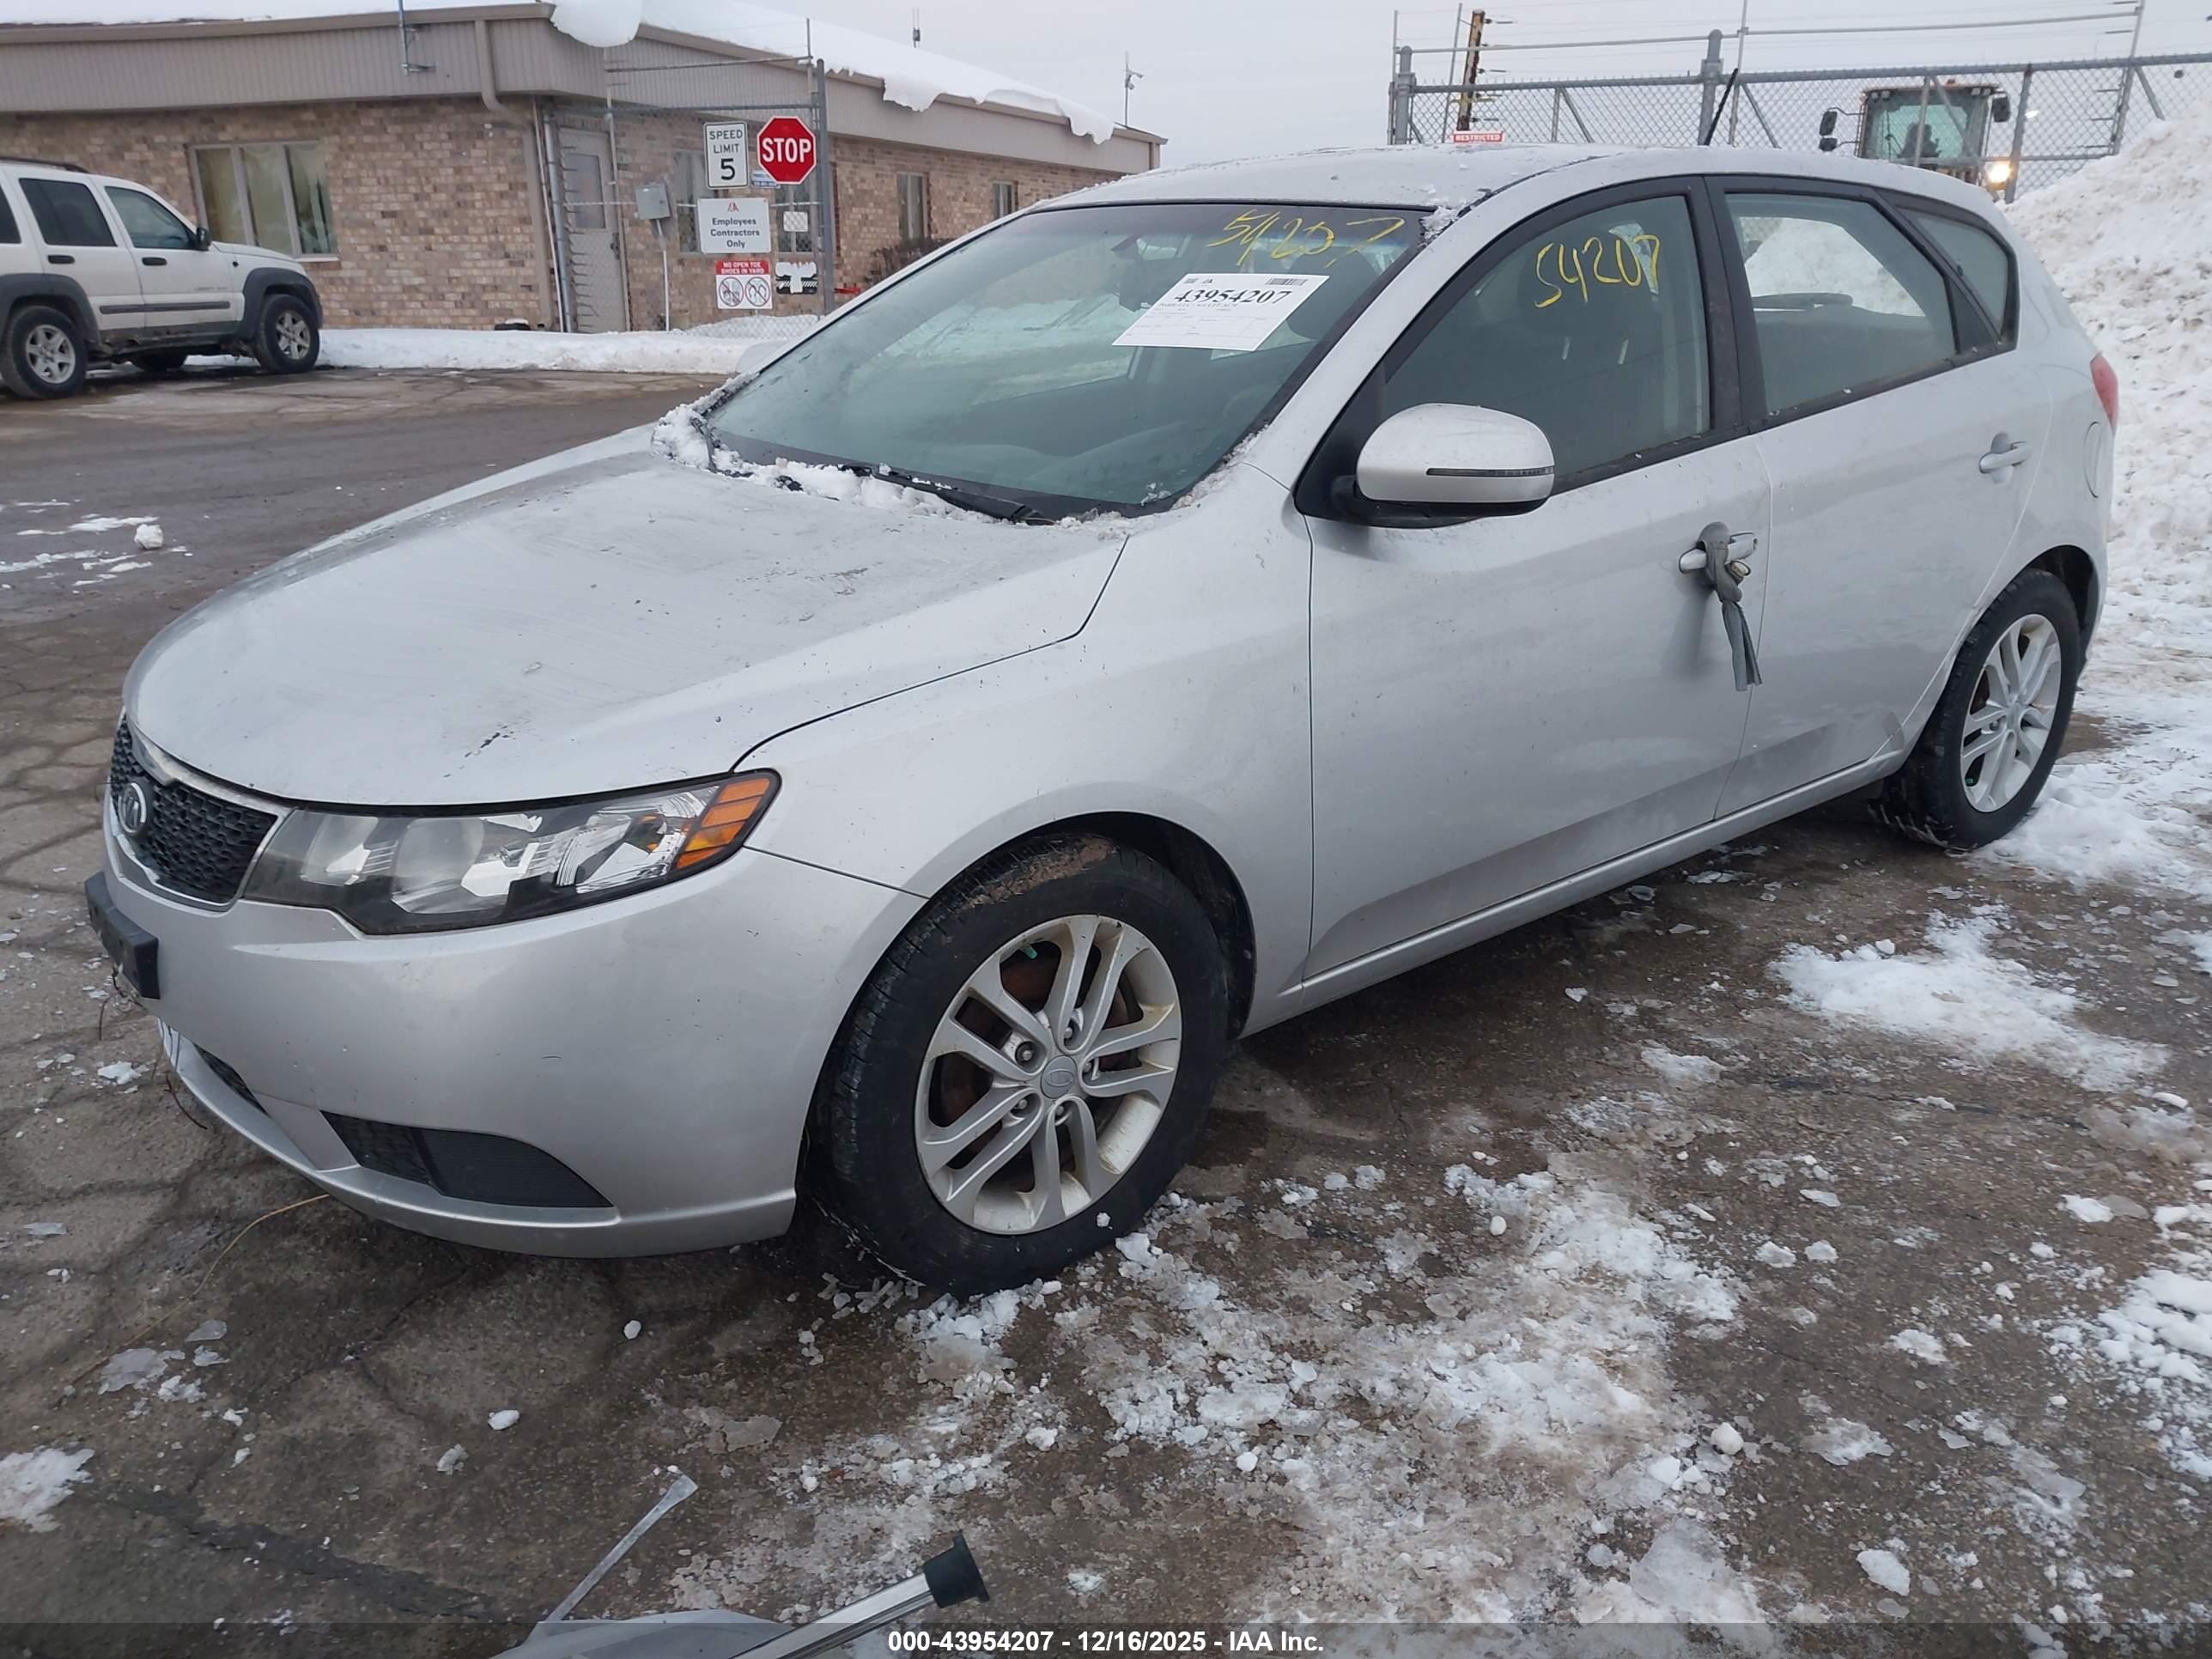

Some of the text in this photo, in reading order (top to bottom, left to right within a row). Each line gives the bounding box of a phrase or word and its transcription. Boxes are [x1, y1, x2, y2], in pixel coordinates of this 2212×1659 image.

[709, 130, 743, 140] SPEED
[714, 143, 739, 154] LIMIT
[762, 137, 812, 163] STOP
[720, 158, 736, 180] 5
[712, 217, 757, 227] Employees
[710, 228, 760, 237] Contractors
[726, 240, 745, 249] Only
[1534, 234, 1661, 308] 54207
[1175, 289, 1291, 304] 43954207
